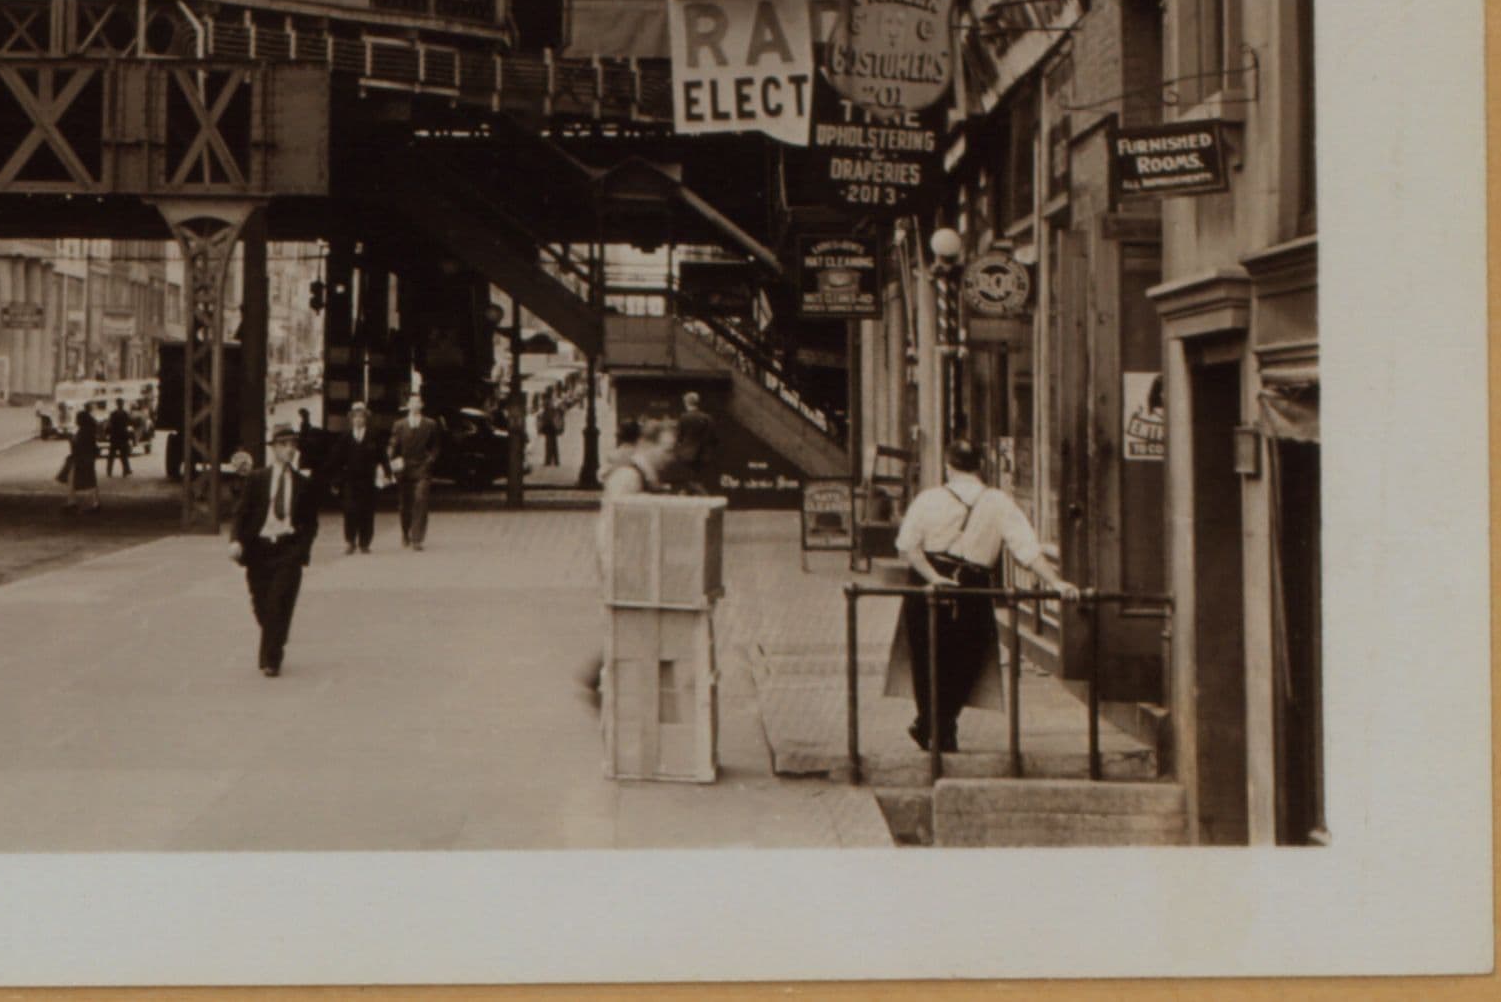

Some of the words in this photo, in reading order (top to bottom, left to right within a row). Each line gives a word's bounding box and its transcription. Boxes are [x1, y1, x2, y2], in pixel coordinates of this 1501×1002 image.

[683, 75, 808, 122] ELECT
[815, 124, 935, 152] UPHOLSTERING
[1116, 132, 1213, 157] FURNISHED
[829, 157, 922, 186] DRAPERIES
[846, 184, 898, 206] 2013
